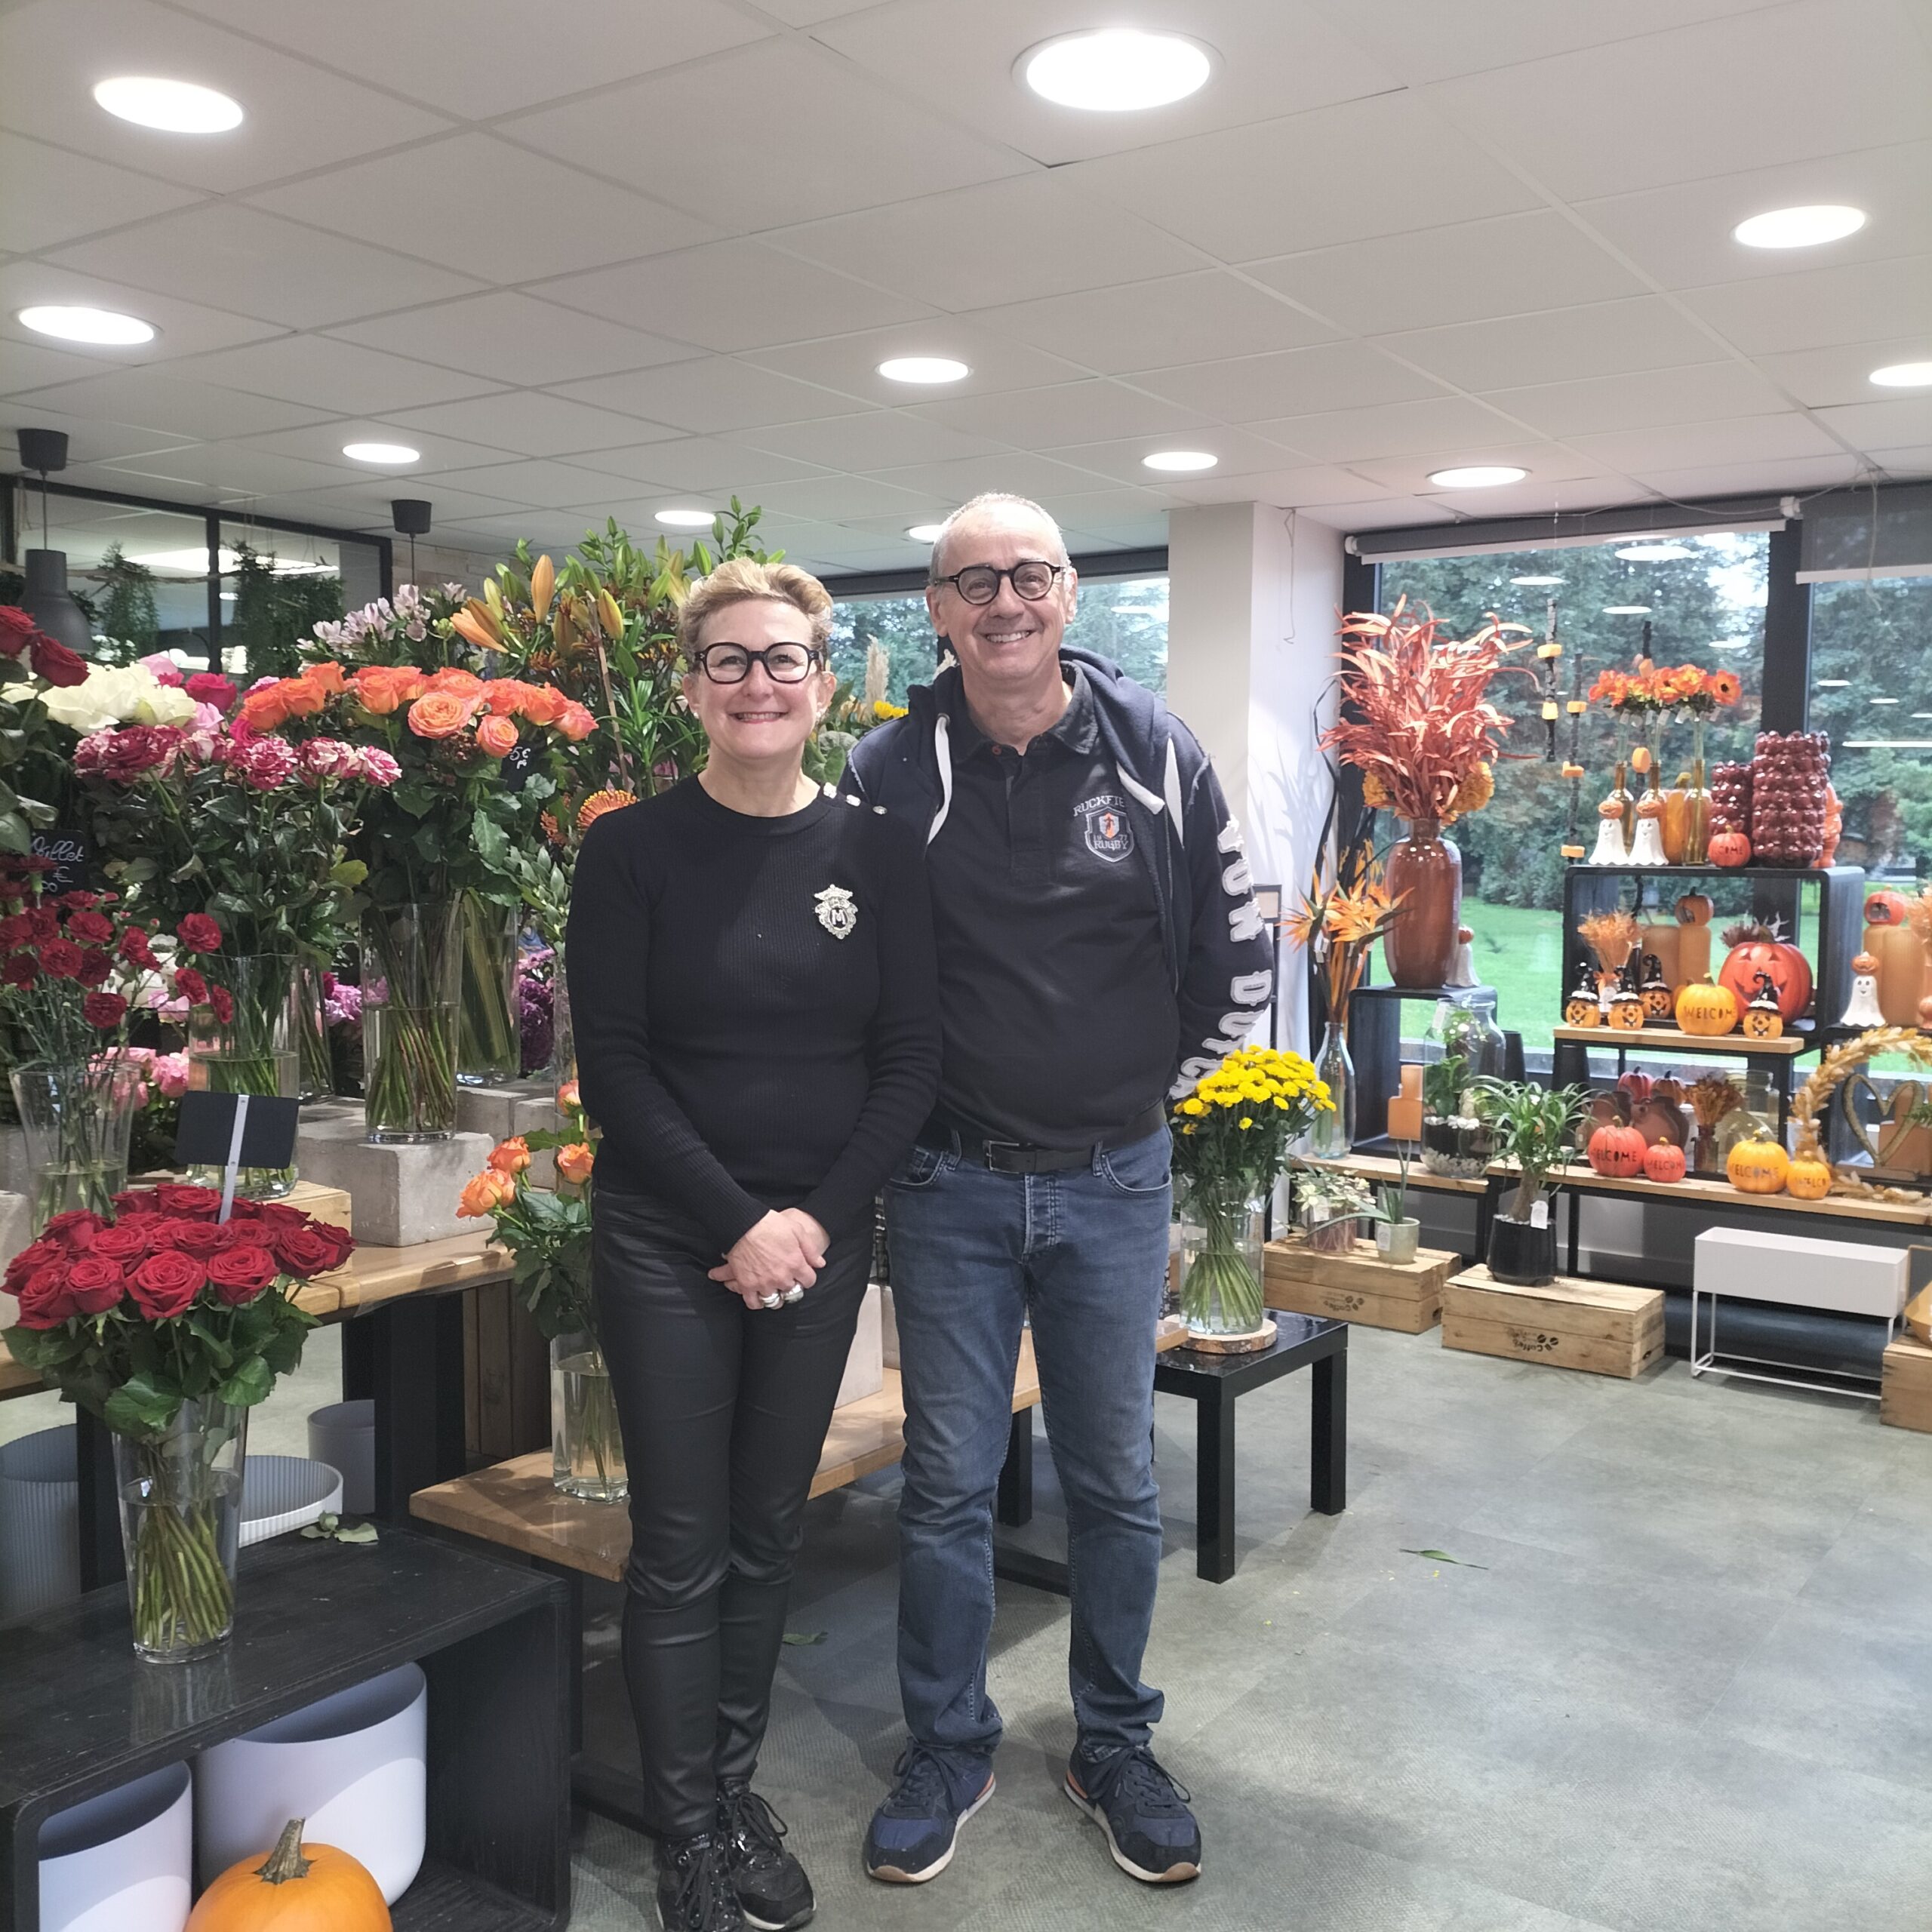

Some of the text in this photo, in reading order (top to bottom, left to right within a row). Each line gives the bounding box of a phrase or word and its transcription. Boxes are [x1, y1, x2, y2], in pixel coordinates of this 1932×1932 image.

[1073, 795, 1125, 817] RUCKFIE
[1094, 839, 1128, 851] RUGBY
[832, 909, 846, 925] M
